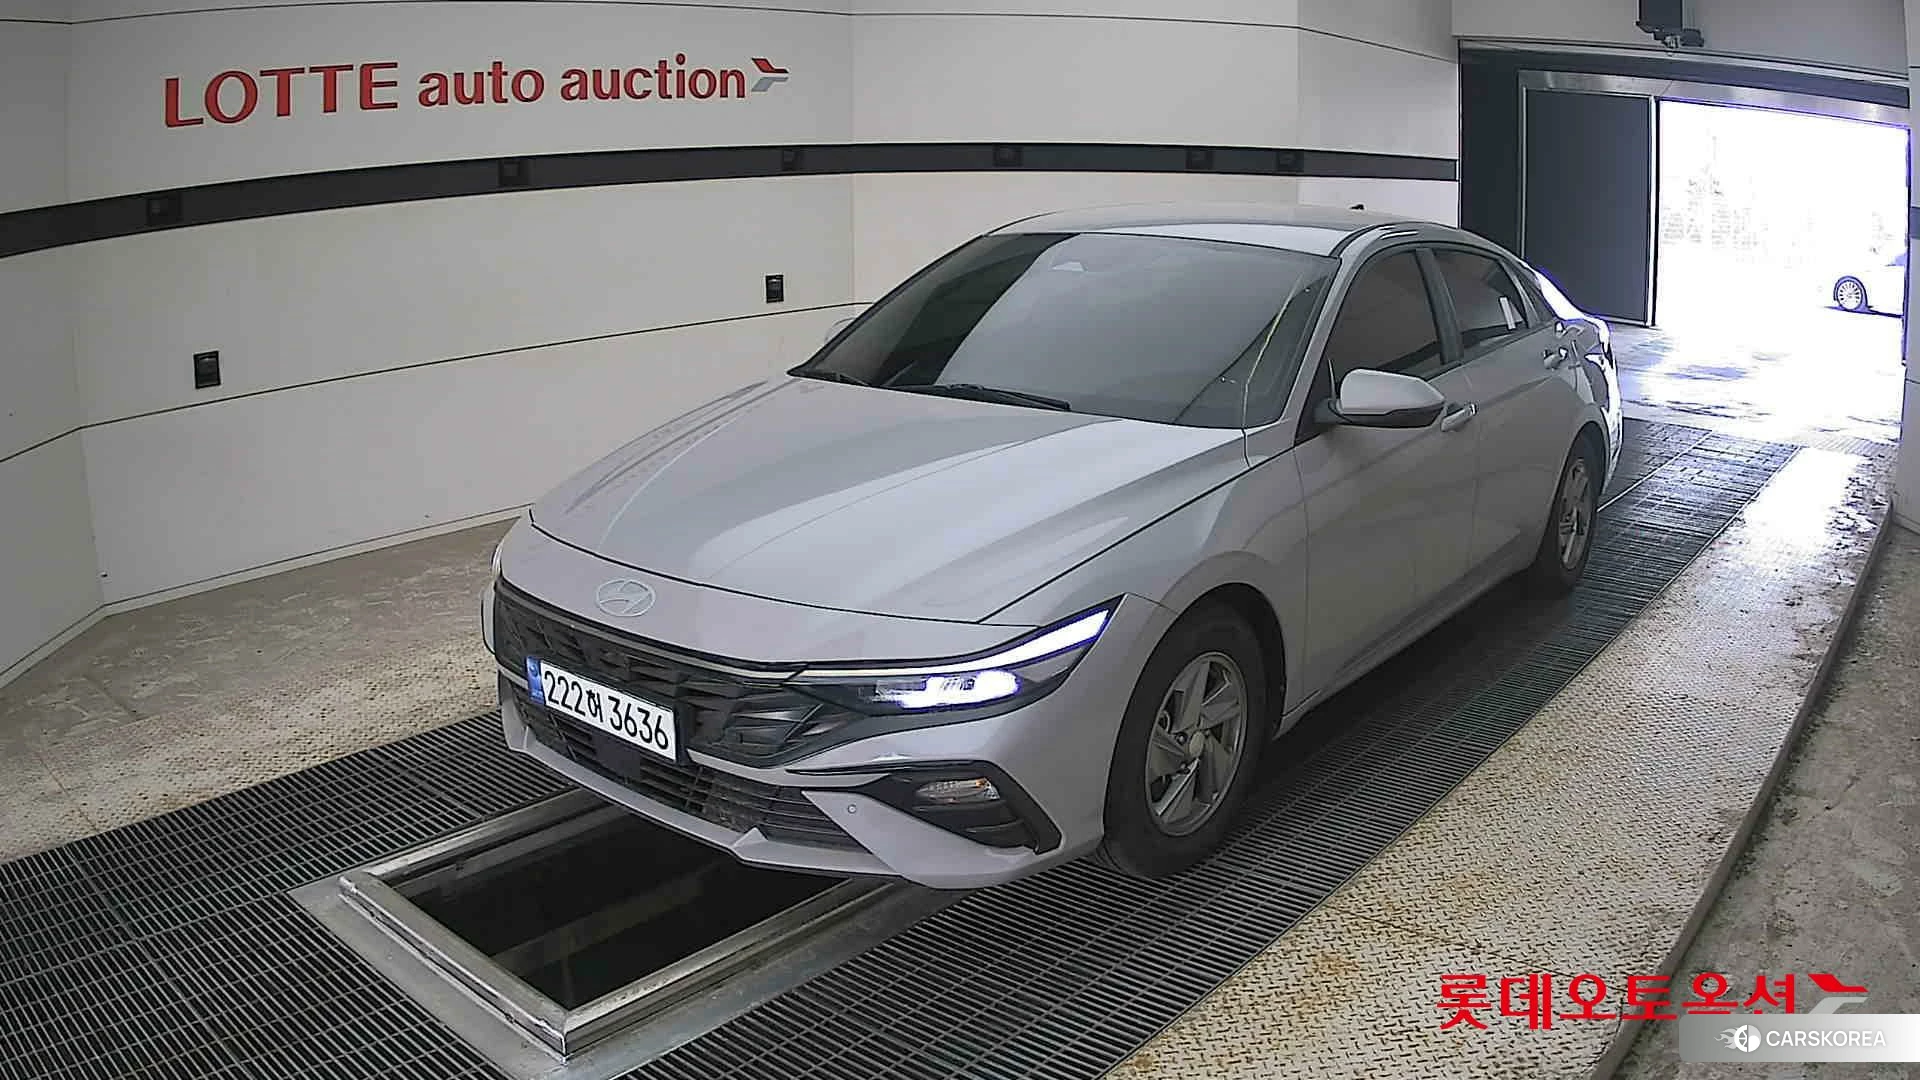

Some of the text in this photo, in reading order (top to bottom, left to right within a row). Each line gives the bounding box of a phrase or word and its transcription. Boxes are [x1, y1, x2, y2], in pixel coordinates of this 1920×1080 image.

[164, 53, 746, 128] LOTTE auto auction
[544, 670, 669, 750] 222허 3636
